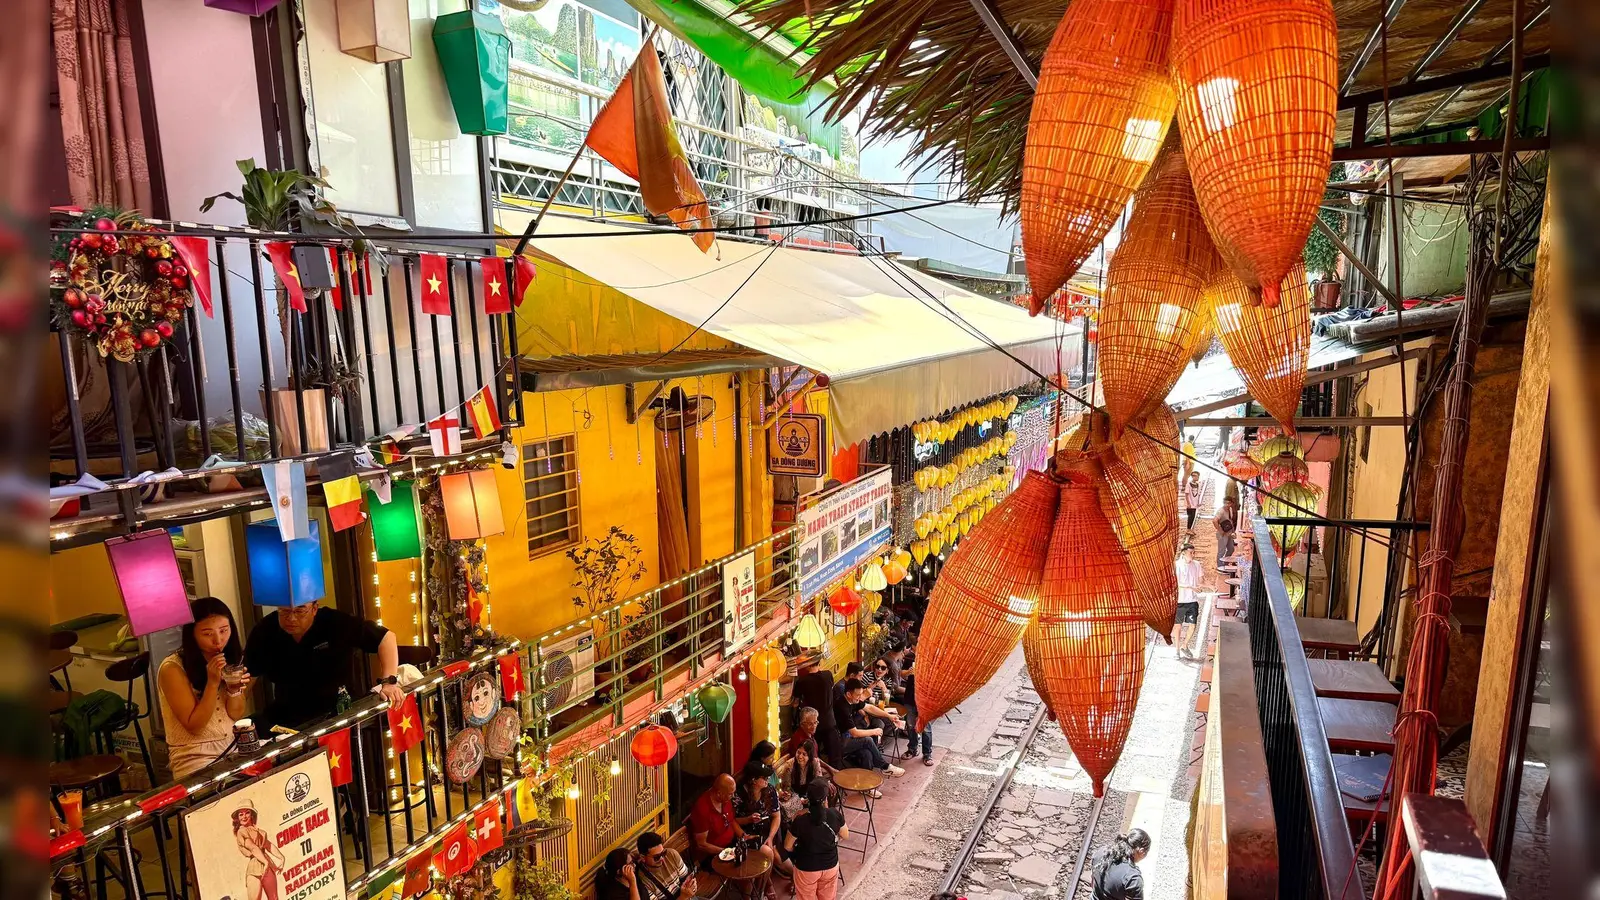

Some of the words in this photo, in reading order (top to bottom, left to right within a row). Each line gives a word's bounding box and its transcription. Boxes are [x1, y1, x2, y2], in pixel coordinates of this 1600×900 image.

[807, 513, 828, 535] HANOI
[828, 503, 848, 524] TRAIN
[848, 492, 870, 514] STREET
[276, 821, 305, 849] COME
[305, 807, 331, 834] BACK
[300, 837, 313, 856] TO
[282, 845, 334, 882] VIETNAM
[285, 858, 336, 896] RAILROAD
[287, 870, 337, 900] ISTORY
